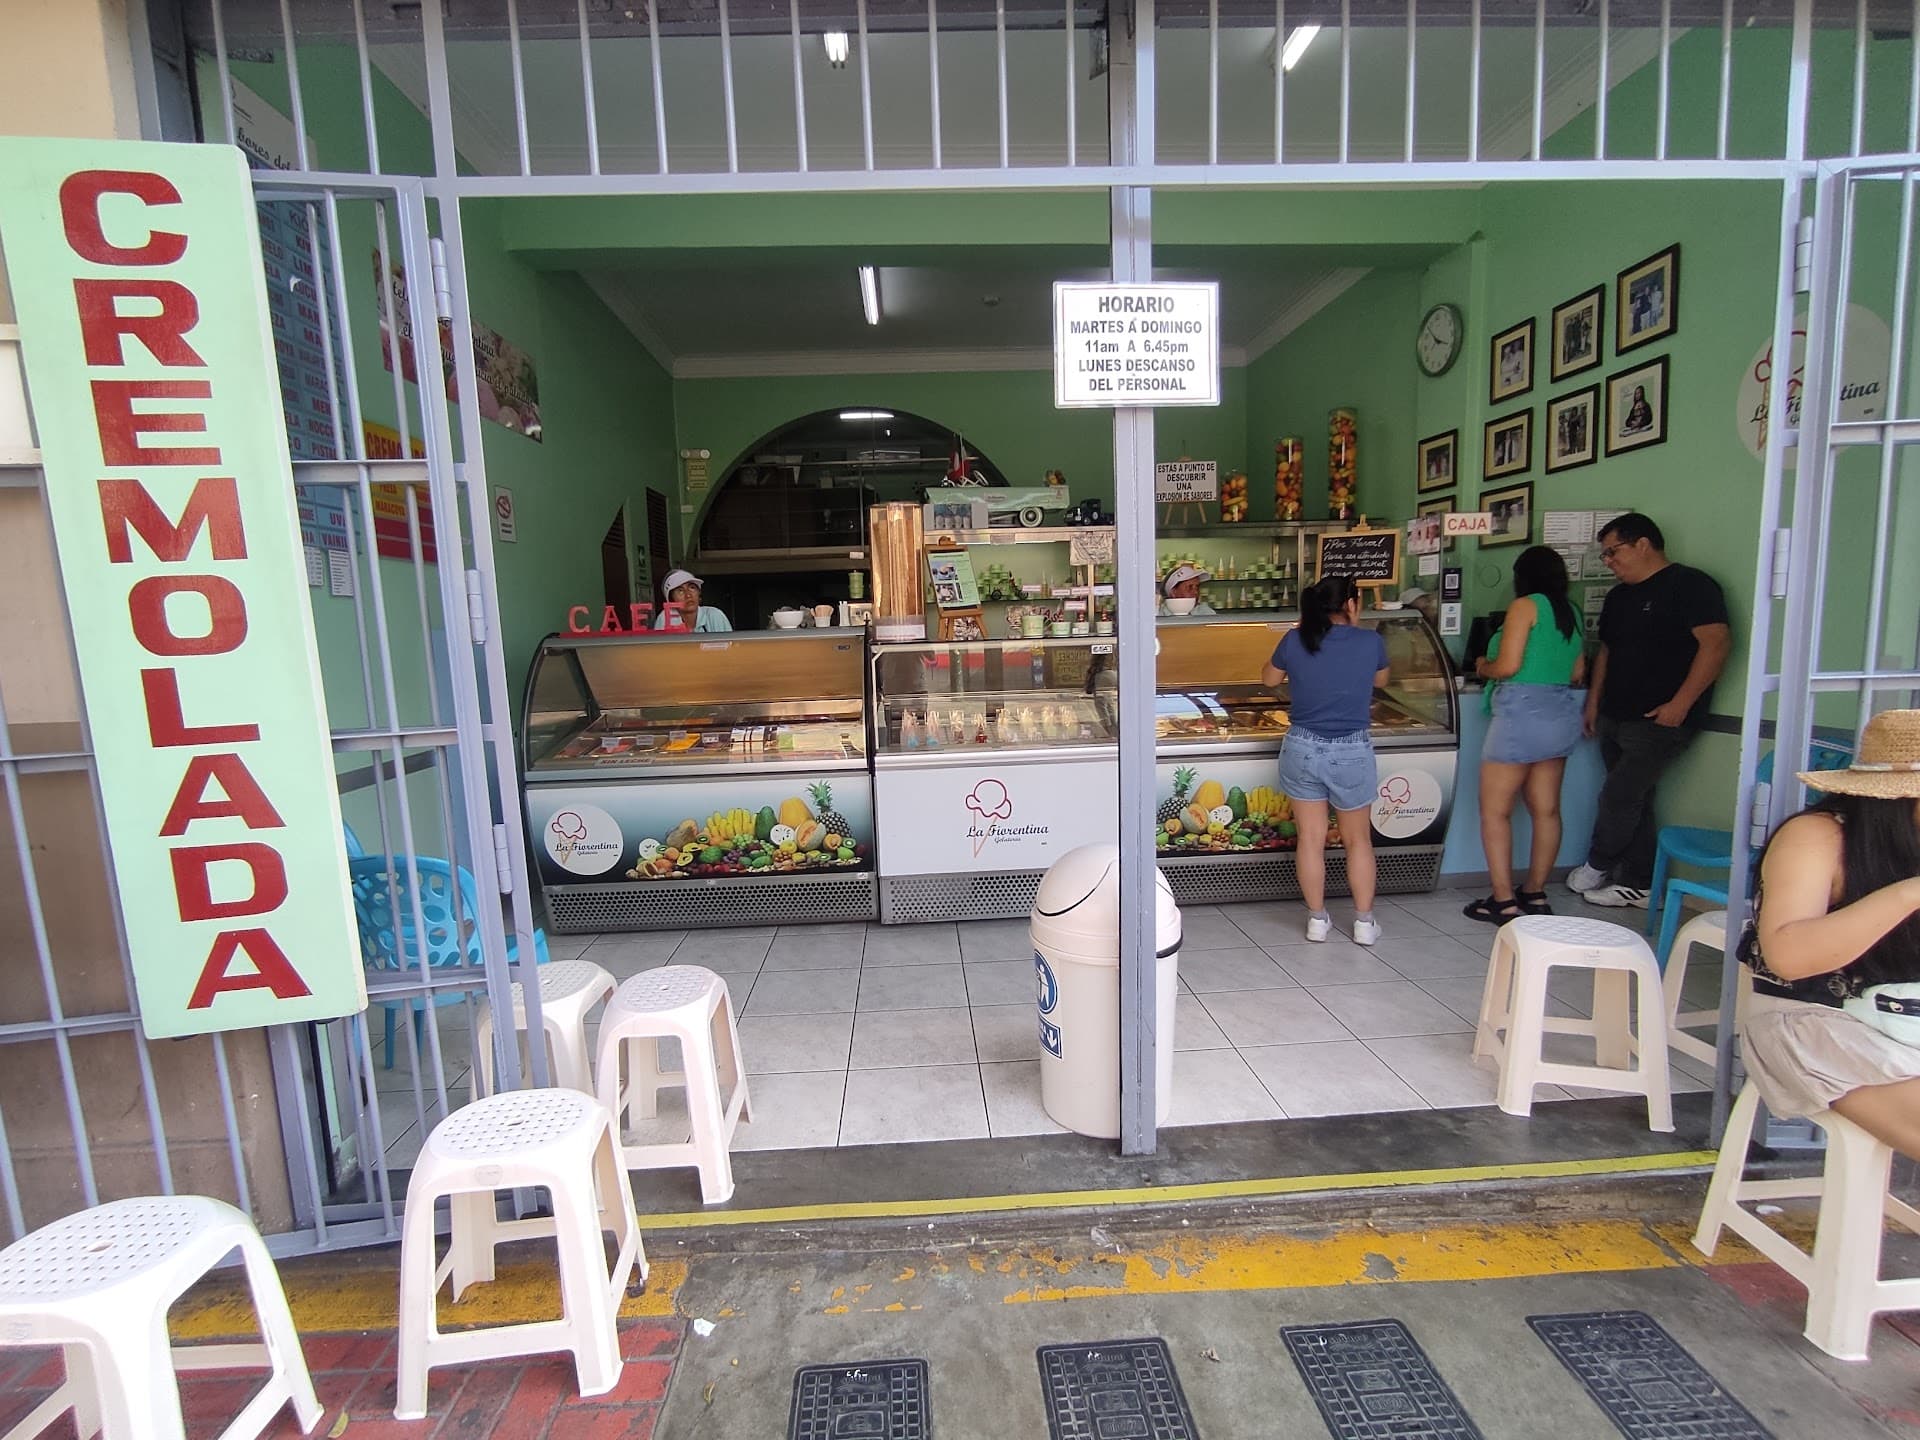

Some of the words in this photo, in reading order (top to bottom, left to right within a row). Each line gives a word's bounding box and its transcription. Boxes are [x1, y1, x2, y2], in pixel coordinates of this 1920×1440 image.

[1098, 296, 1175, 313] HORARIO
[1070, 320, 1124, 334] MARTES
[1141, 320, 1202, 334] DOMINGO
[1085, 339, 1119, 353] 11am
[1127, 340, 1136, 353] A
[1144, 339, 1189, 355] 6.45pm
[1078, 359, 1122, 372] LUNES
[1126, 358, 1195, 372] DESCANSO
[1089, 378, 1113, 391] DEL
[1118, 377, 1186, 391] PERSONAL
[1157, 464, 1177, 473] ESTAS
[1179, 464, 1183, 472] A
[1184, 463, 1205, 472] PUNTO
[1206, 463, 1215, 471] DE
[1166, 473, 1206, 482] DESCUBRIR
[1176, 482, 1192, 491] UNA
[1184, 491, 1190, 500] DE
[1447, 517, 1487, 531] CAJA
[59, 170, 313, 1010] CREMOLADA
[568, 602, 686, 632] CAFE
[966, 826, 984, 838] La
[987, 824, 1049, 837] Fiorentina
[555, 842, 568, 852] La
[572, 841, 618, 851] Fiorentina
